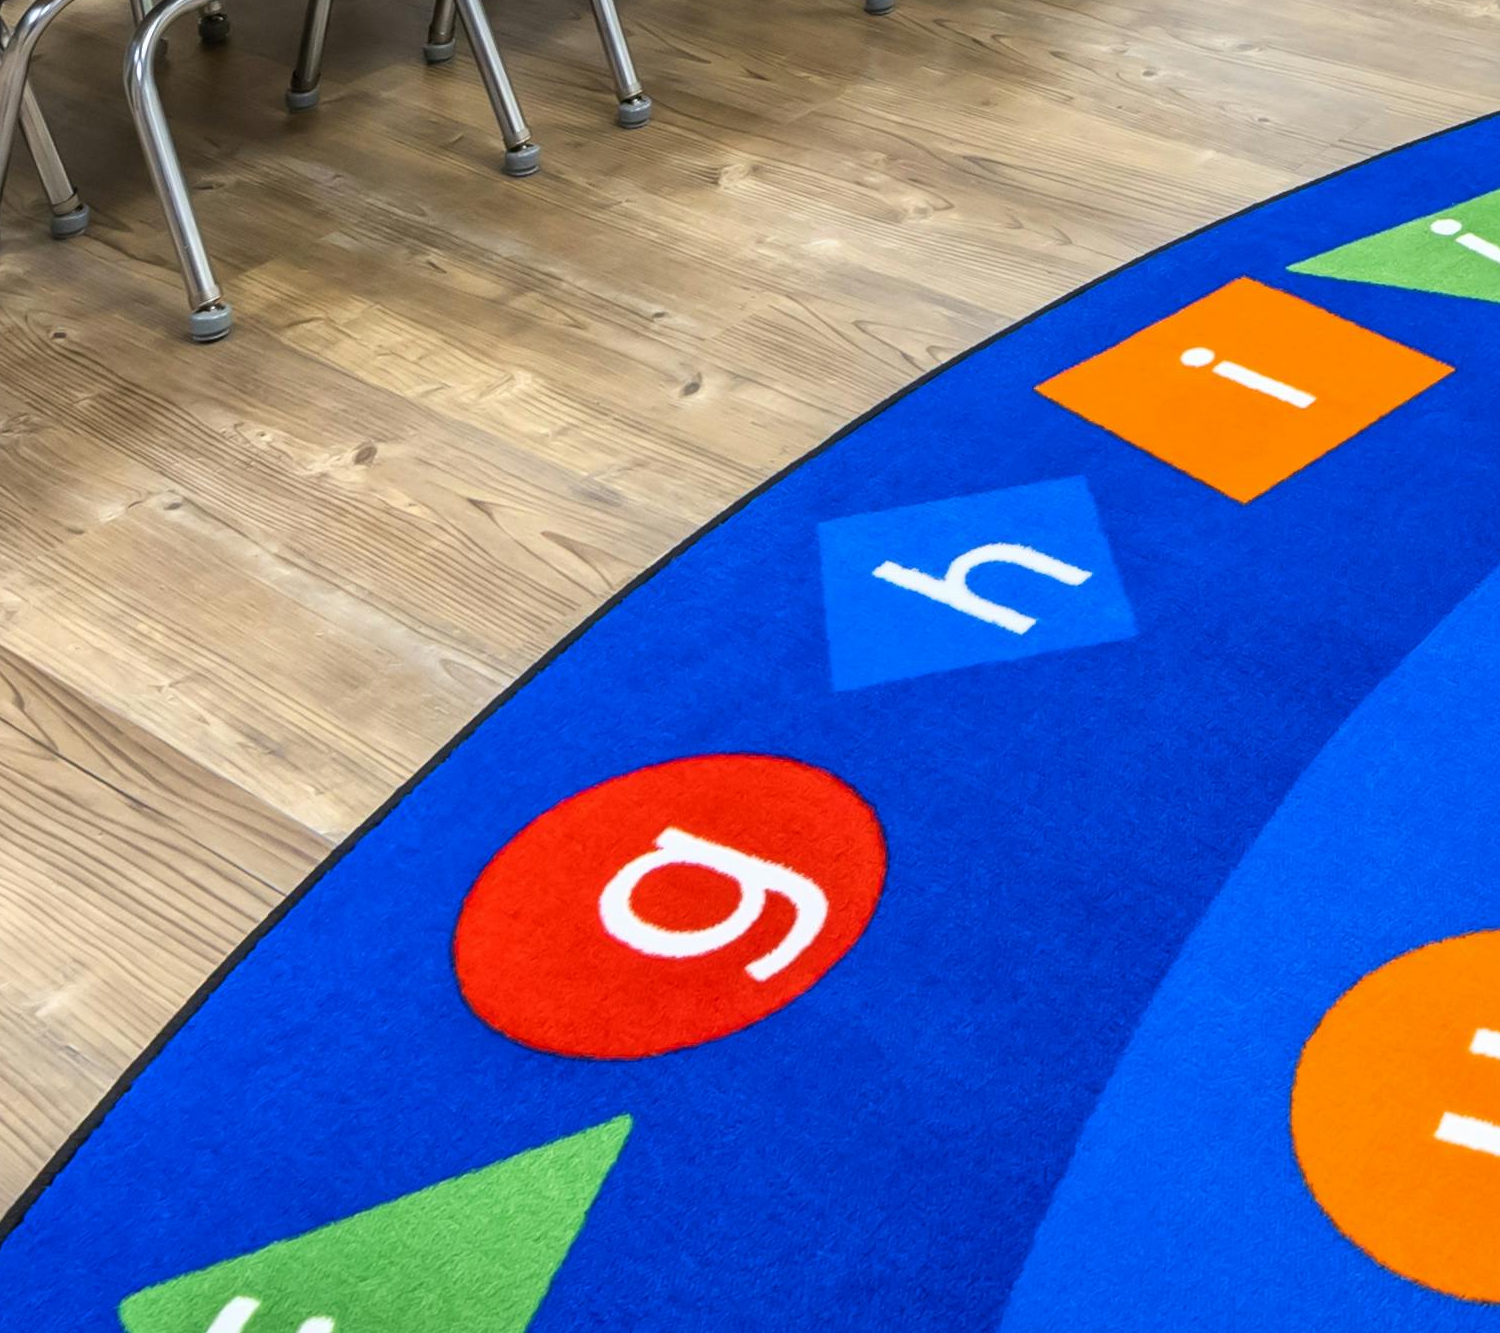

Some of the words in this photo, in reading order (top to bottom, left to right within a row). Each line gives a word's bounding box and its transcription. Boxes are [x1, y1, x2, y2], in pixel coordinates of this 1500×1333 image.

[599, 828, 828, 981] g
[873, 543, 1091, 634] h
[1180, 347, 1316, 409] i
